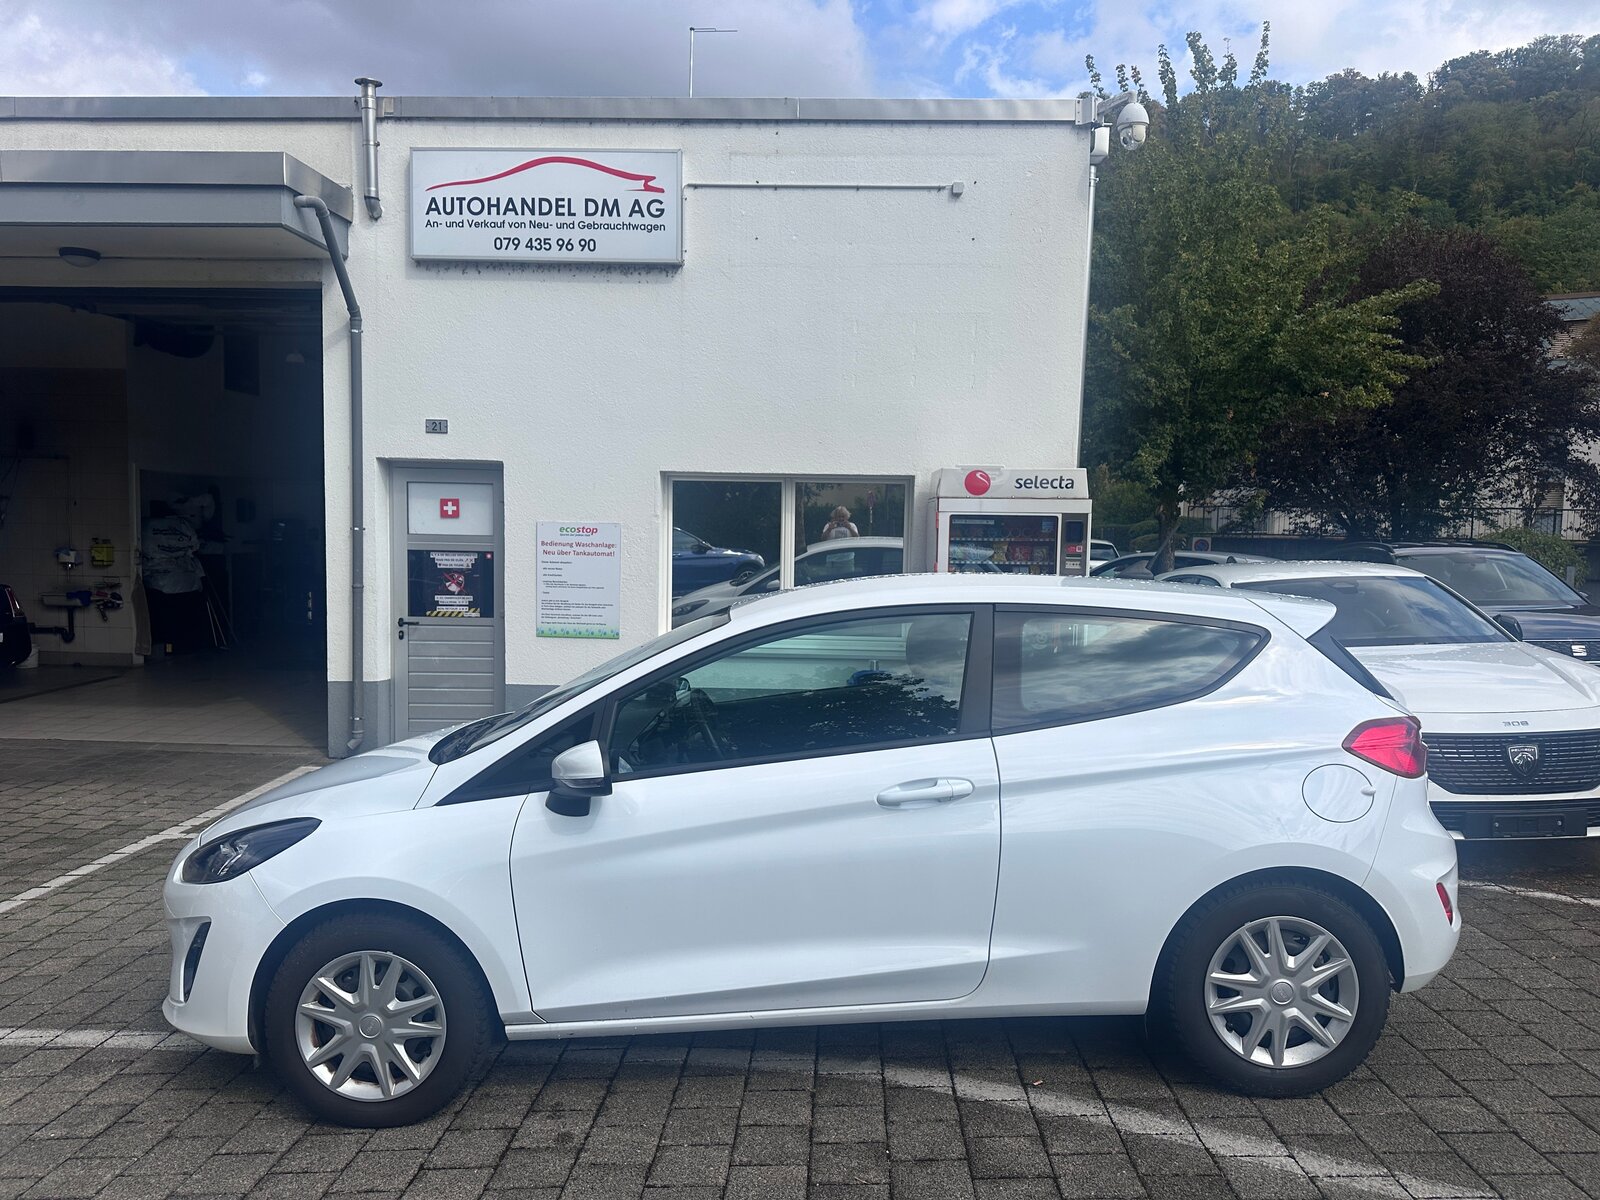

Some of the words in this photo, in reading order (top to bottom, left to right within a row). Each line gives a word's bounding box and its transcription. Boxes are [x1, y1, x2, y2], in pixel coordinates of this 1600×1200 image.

[425, 196, 577, 217] AUTOHANDEL
[584, 198, 621, 218] DM
[628, 198, 666, 219] AG
[425, 219, 443, 229] An-
[445, 219, 464, 229] und
[467, 219, 506, 229] Verkauf
[508, 221, 526, 230] von
[529, 220, 553, 230] Neu-
[556, 220, 575, 230] und
[578, 220, 666, 232] Gebrauchtwagen
[494, 237, 520, 251] 079
[525, 238, 552, 251] 435
[556, 238, 574, 252] 96
[578, 239, 596, 252] 90
[431, 421, 442, 431] 21
[1015, 476, 1074, 489] selecta
[559, 526, 598, 535] ecostop
[575, 541, 617, 549] Waschanlage:
[573, 549, 615, 557] Tankautomat!
